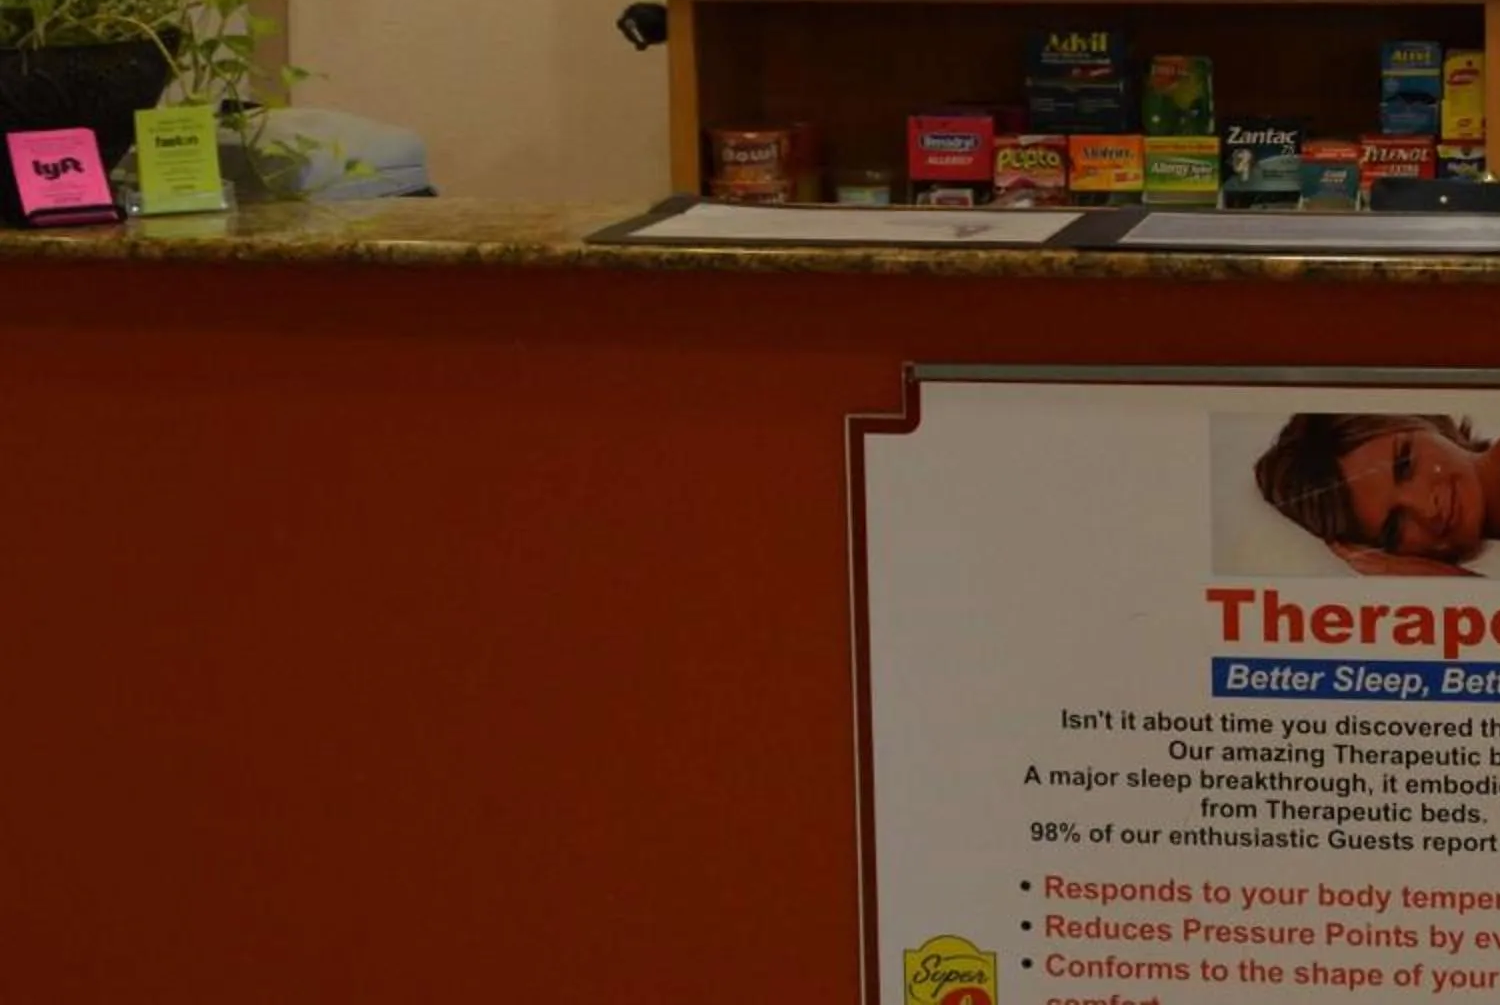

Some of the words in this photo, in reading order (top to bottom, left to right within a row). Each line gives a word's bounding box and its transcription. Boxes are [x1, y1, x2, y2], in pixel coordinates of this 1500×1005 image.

[1045, 32, 1109, 52] Advil
[1226, 126, 1298, 144] Zantac
[32, 157, 85, 180] lyft
[1360, 146, 1431, 163] TYLENOL
[1226, 663, 1325, 691] Better
[1333, 665, 1429, 700] Sleep,
[1061, 708, 1113, 731] Isn't
[1121, 710, 1136, 731] it
[1142, 711, 1214, 732] about
[1219, 712, 1274, 734] time
[1281, 719, 1327, 740] you
[1335, 715, 1473, 738] discovered
[1168, 740, 1215, 761] Our
[1221, 743, 1325, 769] amazing
[1333, 743, 1481, 770] Therapeutic
[1023, 765, 1042, 785] A
[1049, 767, 1120, 792] major
[1126, 768, 1192, 794] sleep
[1200, 770, 1374, 798] breakthrough,
[1382, 773, 1398, 794] it
[1200, 797, 1257, 819] from
[1265, 799, 1412, 826] Therapeutic
[1421, 802, 1488, 824] beds.
[1030, 821, 1081, 843] 98%
[1089, 823, 1113, 844] of
[1120, 828, 1162, 844] our
[1168, 826, 1319, 849] enthusiastic
[1327, 830, 1414, 852] Guests
[1423, 834, 1497, 857] report
[1044, 875, 1193, 906] Responds
[1202, 881, 1232, 904] to
[1241, 886, 1310, 911] your
[1318, 882, 1392, 914] body
[1045, 914, 1173, 942] Reduces
[1183, 918, 1315, 946] Pressure
[1325, 922, 1419, 948] Points
[1429, 924, 1465, 955] by
[911, 952, 989, 999] Super
[1045, 953, 1191, 981] Conforms
[1199, 959, 1229, 982] to
[1238, 958, 1284, 984] the
[1294, 961, 1384, 992] shape
[1393, 962, 1424, 987] of
[1431, 969, 1500, 993] your
